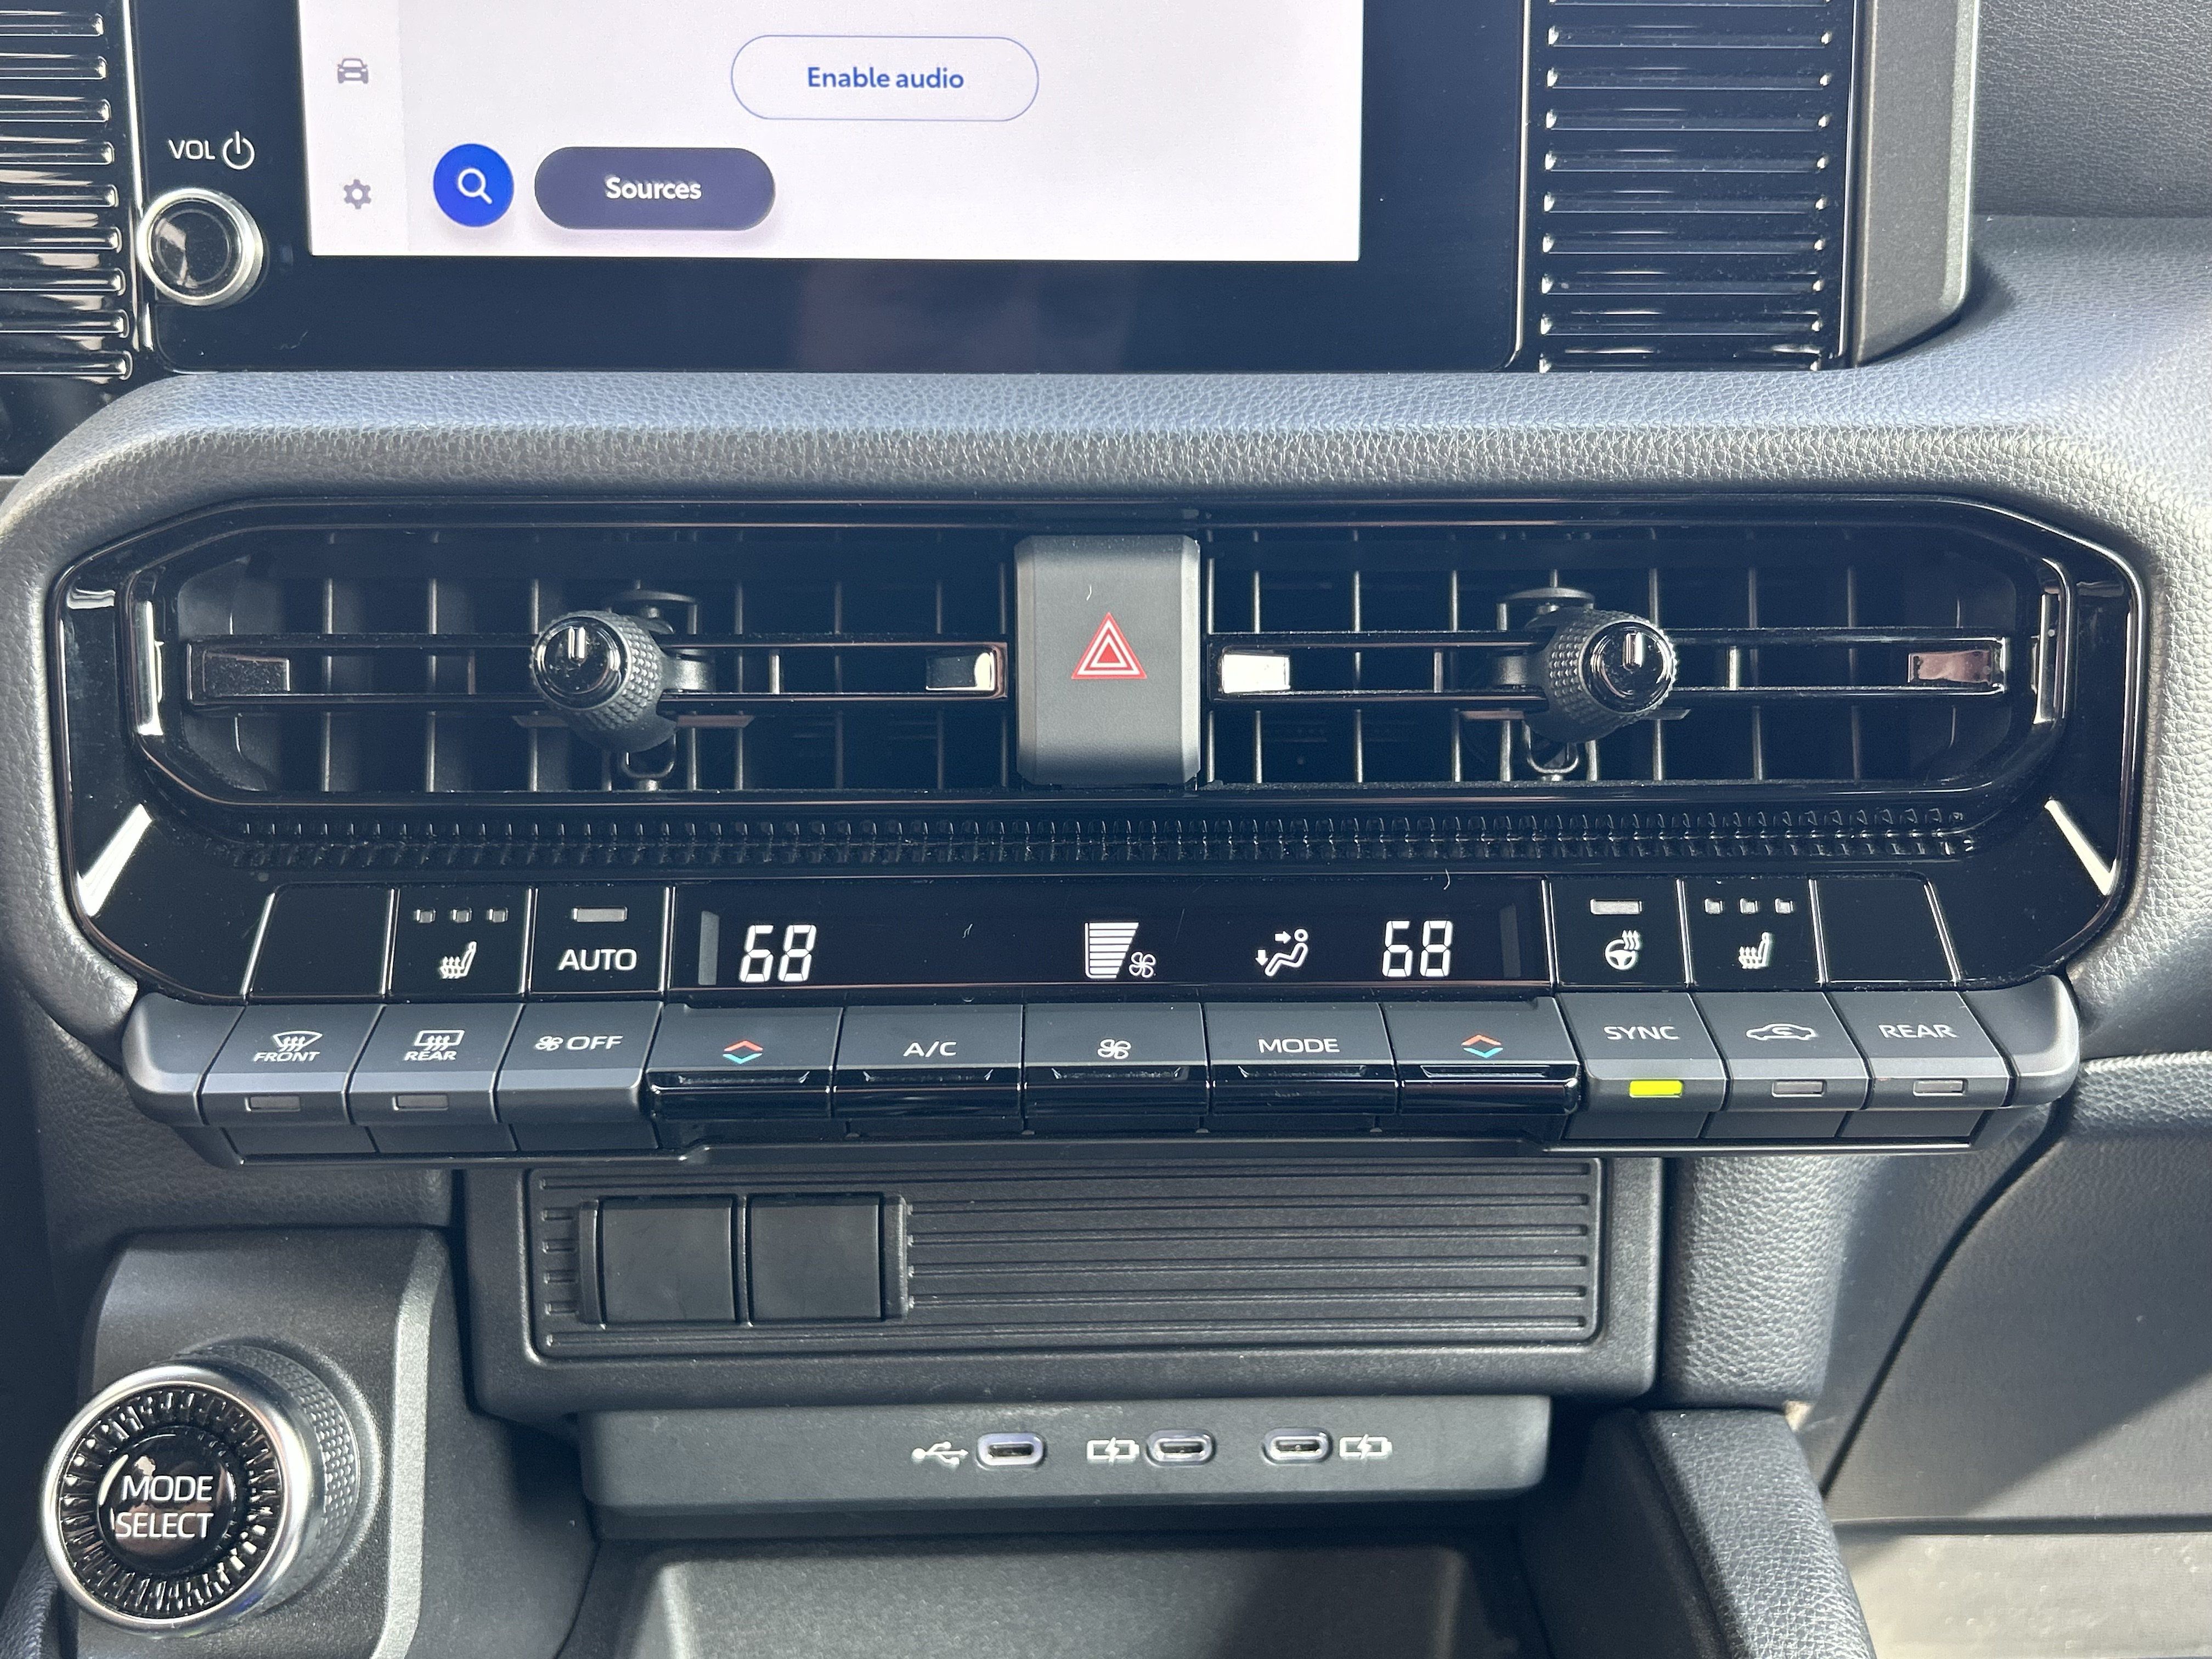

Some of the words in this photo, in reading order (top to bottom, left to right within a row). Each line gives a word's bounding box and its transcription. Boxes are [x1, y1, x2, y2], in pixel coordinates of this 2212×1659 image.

[808, 67, 890, 88] Enable
[896, 67, 964, 88] audio
[168, 139, 215, 162] VOL
[605, 176, 702, 201] Sources
[558, 948, 637, 971] AUTO
[739, 924, 817, 982] 68
[1382, 920, 1454, 978] 68
[1604, 1025, 1680, 1040] SYNC
[1878, 1024, 1957, 1039] REAR
[567, 1035, 623, 1050] OFF
[903, 1041, 957, 1057] A/C
[1258, 1038, 1340, 1054] MODE
[253, 1051, 320, 1062] FRONT
[404, 1050, 457, 1061] REAR
[121, 1475, 213, 1502] MODE
[115, 1512, 214, 1538] SELECT
